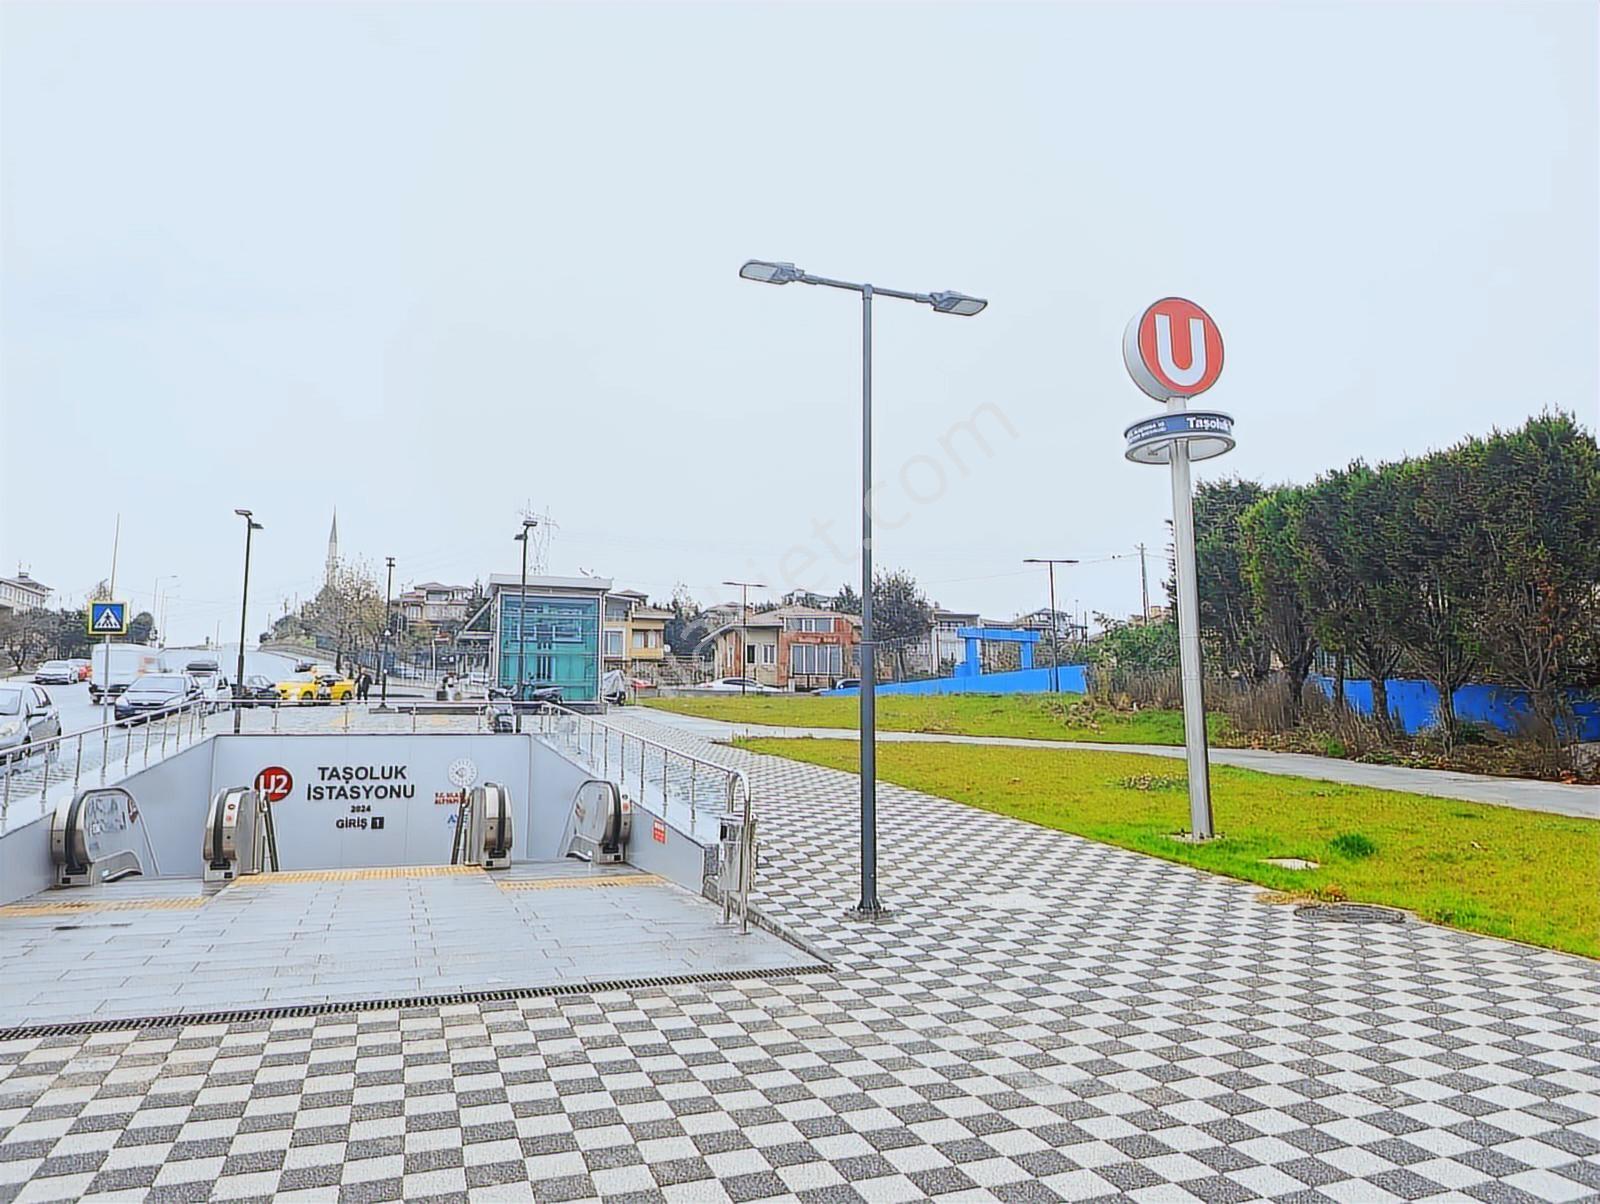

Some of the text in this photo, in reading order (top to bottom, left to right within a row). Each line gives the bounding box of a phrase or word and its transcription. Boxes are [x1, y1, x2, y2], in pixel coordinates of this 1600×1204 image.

[1154, 313, 1207, 387] U
[318, 765, 407, 783] TAŞOLUK
[259, 774, 288, 794] U2
[307, 783, 415, 800] İSTASYONU
[350, 805, 371, 813] 2024
[335, 817, 368, 830] GİRİŞ
